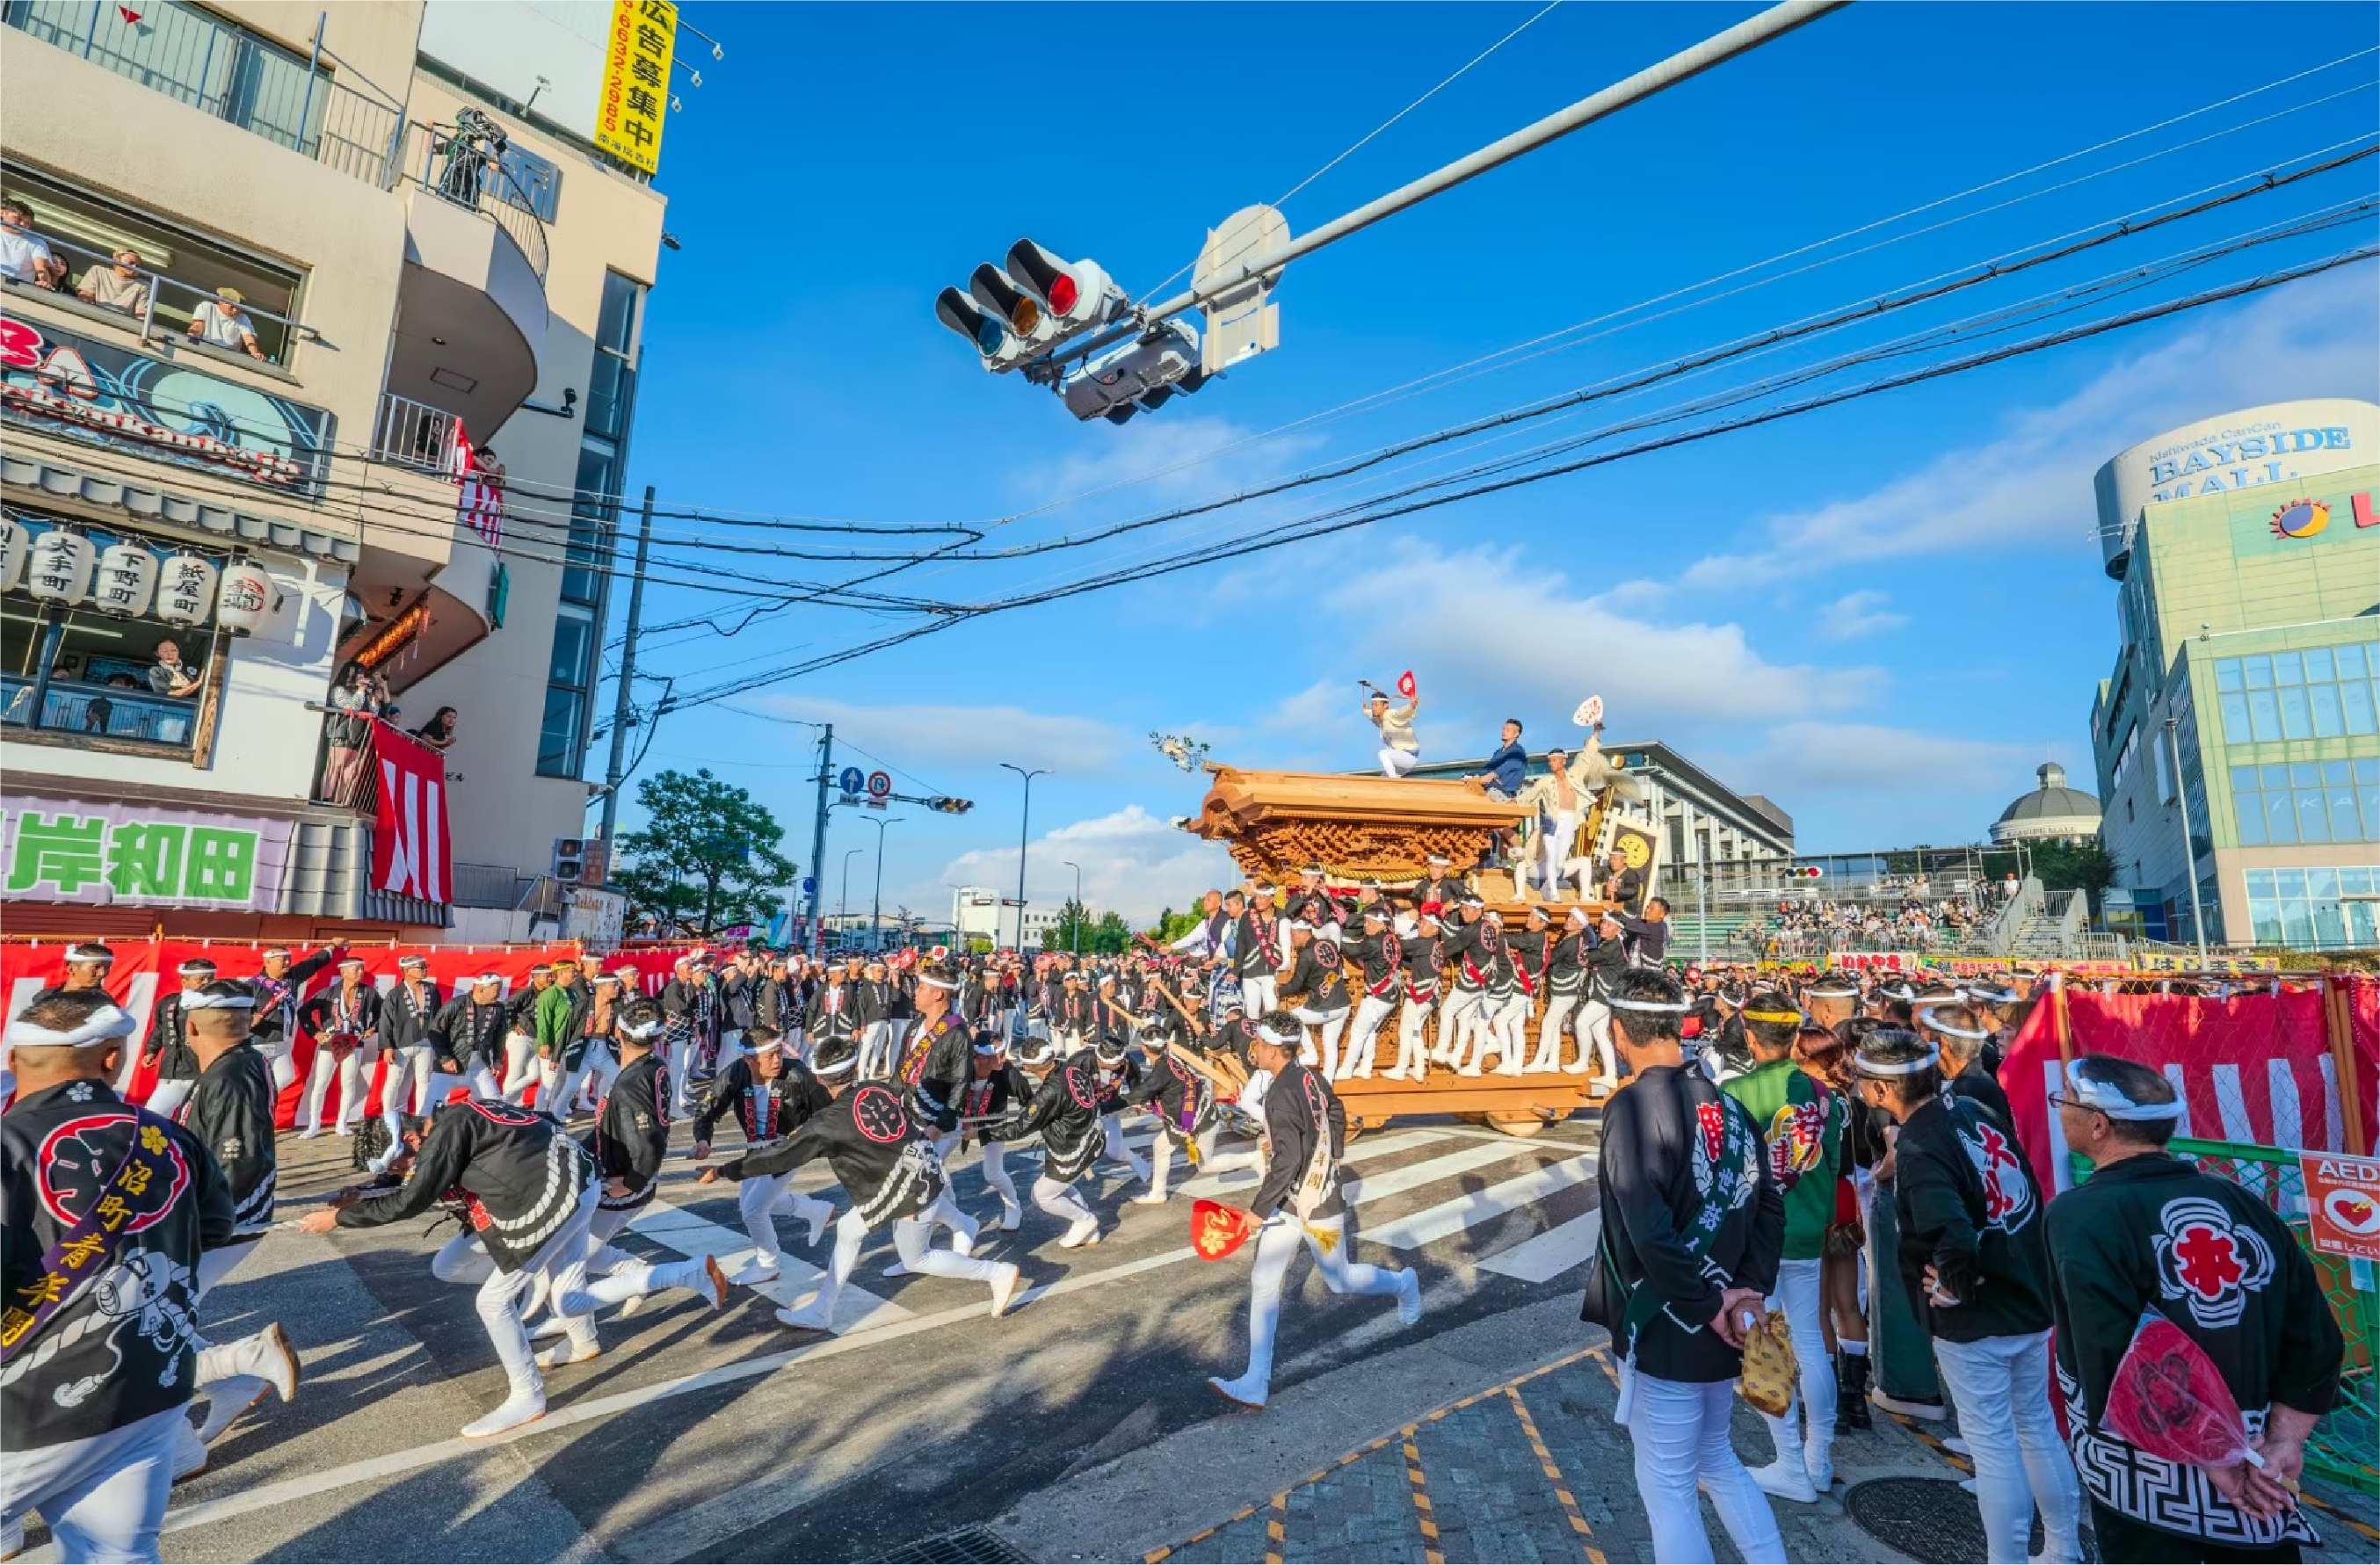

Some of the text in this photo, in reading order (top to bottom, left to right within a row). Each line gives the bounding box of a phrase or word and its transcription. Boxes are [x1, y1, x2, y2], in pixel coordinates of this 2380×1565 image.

[624, 0, 677, 147] 広告募集中
[2149, 426, 2351, 487] BAYSIDE
[2221, 420, 2281, 440] CanCan
[42, 537, 78, 592] 大手町
[108, 551, 146, 605] 下野町
[172, 563, 207, 614] 紙屋町
[5, 810, 261, 903] 岸和田
[2318, 1159, 2379, 1182] AED
